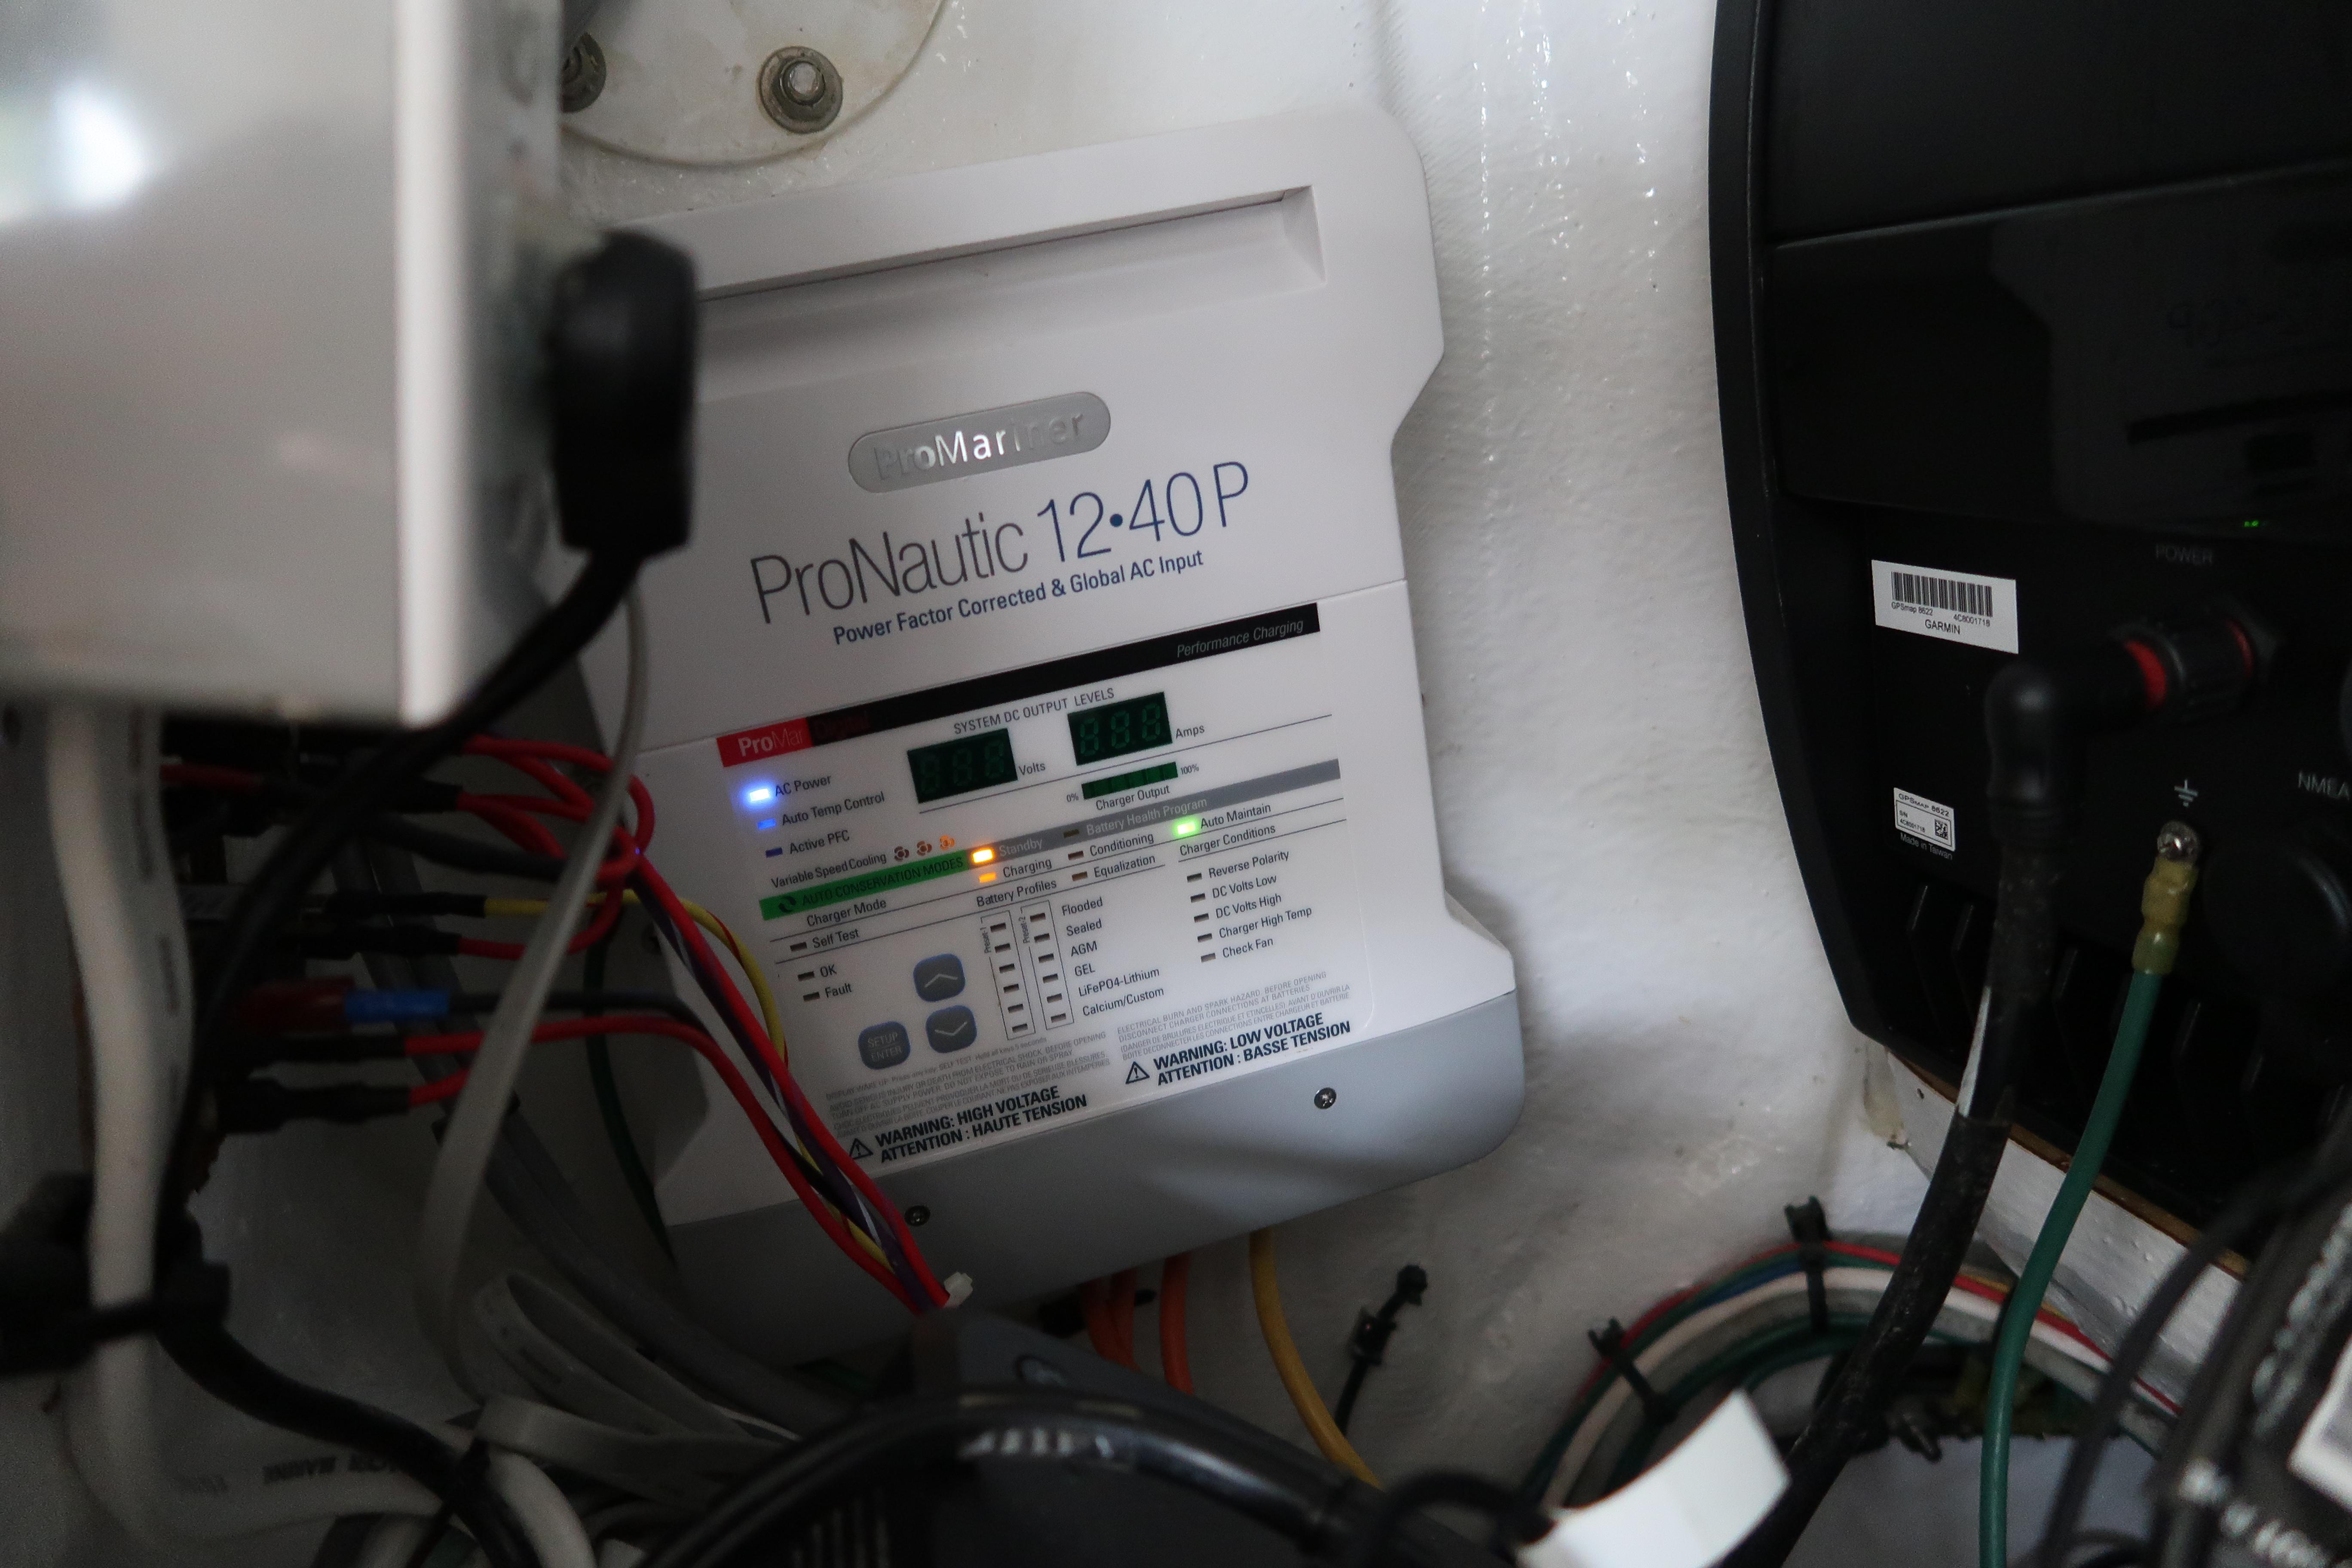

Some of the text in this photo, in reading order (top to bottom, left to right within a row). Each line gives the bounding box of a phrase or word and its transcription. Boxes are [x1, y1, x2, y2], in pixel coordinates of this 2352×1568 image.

[2156, 543, 2212, 566] POWER
[751, 512, 1028, 623] ProNautic
[833, 551, 1204, 645] Power Factor Corrected & Global AC Input
[1891, 601, 1933, 616] GPSmap 8622
[1925, 619, 1960, 634] GARMIN
[1177, 621, 1303, 658] Performance Charging
[954, 688, 1115, 735] SYSTEM DC OUTPUT LEVELS
[1176, 726, 1205, 739] Amps
[1019, 763, 1046, 775] Volts
[1181, 764, 1199, 775] 100%
[775, 775, 832, 796] AC Power
[1066, 793, 1079, 802] 0%
[2299, 771, 2349, 801] NMEA
[783, 791, 885, 825] Auto Temp Control
[1096, 786, 1170, 811] Charger Output
[1087, 798, 1207, 836] Battery Health Program
[1201, 803, 1271, 829] Auto Maintain
[1932, 805, 1949, 817] 8622
[790, 830, 850, 854] Active PFC
[999, 839, 1042, 857] Standby
[1090, 833, 1154, 856] Conditioning
[1180, 824, 1276, 856] Charger Conditions
[1900, 832, 1953, 860] Made in Taiwan
[772, 853, 887, 888] Variable Speed Cooling
[1003, 860, 1052, 878] Charging
[1094, 855, 1156, 878] Equalization
[1209, 851, 1289, 878] Reverse Polarity
[802, 857, 963, 905] AUTO CONSERVATION MODES
[977, 879, 1057, 906] Battery Profiles
[1213, 875, 1277, 898] DC Volts Low
[807, 899, 887, 927] Charger Mode
[1062, 897, 1103, 916] Flooded
[1216, 893, 1281, 918] DC Volts High
[1019, 916, 1030, 943] Preset-2
[1066, 919, 1102, 936] Sealed
[1219, 907, 1312, 938] Charger High Temp
[812, 929, 859, 948] Self Test
[980, 927, 991, 953] Preset-1
[1071, 941, 1097, 957] AGM
[1222, 938, 1273, 958] Check Fan
[821, 965, 837, 977] OK
[1075, 963, 1096, 977] GEL
[825, 983, 852, 998] Fault
[1078, 968, 1160, 997] LiFePO4-Lithium
[1083, 988, 1164, 1016] Calcium/Custom
[1116, 1017, 1161, 1034] ELECTRICAL
[1162, 1010, 1185, 1022] BURN
[1185, 1005, 1203, 1015] AND
[1204, 998, 1228, 1010] SPARK
[1264, 980, 1292, 994] BEFORE
[1293, 971, 1327, 986] OPENING
[1287, 995, 1309, 1006] AVANT
[1118, 1023, 1167, 1042] DISCONNECT
[1168, 1013, 1204, 1028] CHARGER
[1205, 998, 1259, 1018] CONNECTIONS
[1260, 995, 1269, 1003] AT
[1253, 1013, 1274, 1024] ENTRE
[868, 1032, 897, 1047] SETUP
[1073, 1031, 1106, 1046] OPENING
[1153, 1012, 1323, 1069] WARNING: LOW VOLTAGE
[871, 1045, 902, 1062] ENTER
[1158, 1053, 1234, 1086] ATTENTION
[1243, 1038, 1289, 1062] BASSE
[1291, 1020, 1350, 1047] TENSION
[874, 1085, 1060, 1147] WARNING: HIGH VOLTAGE
[881, 1128, 963, 1163] ATTENTION
[973, 1112, 1021, 1137] HAUTE
[1023, 1094, 1087, 1123] TENSION
